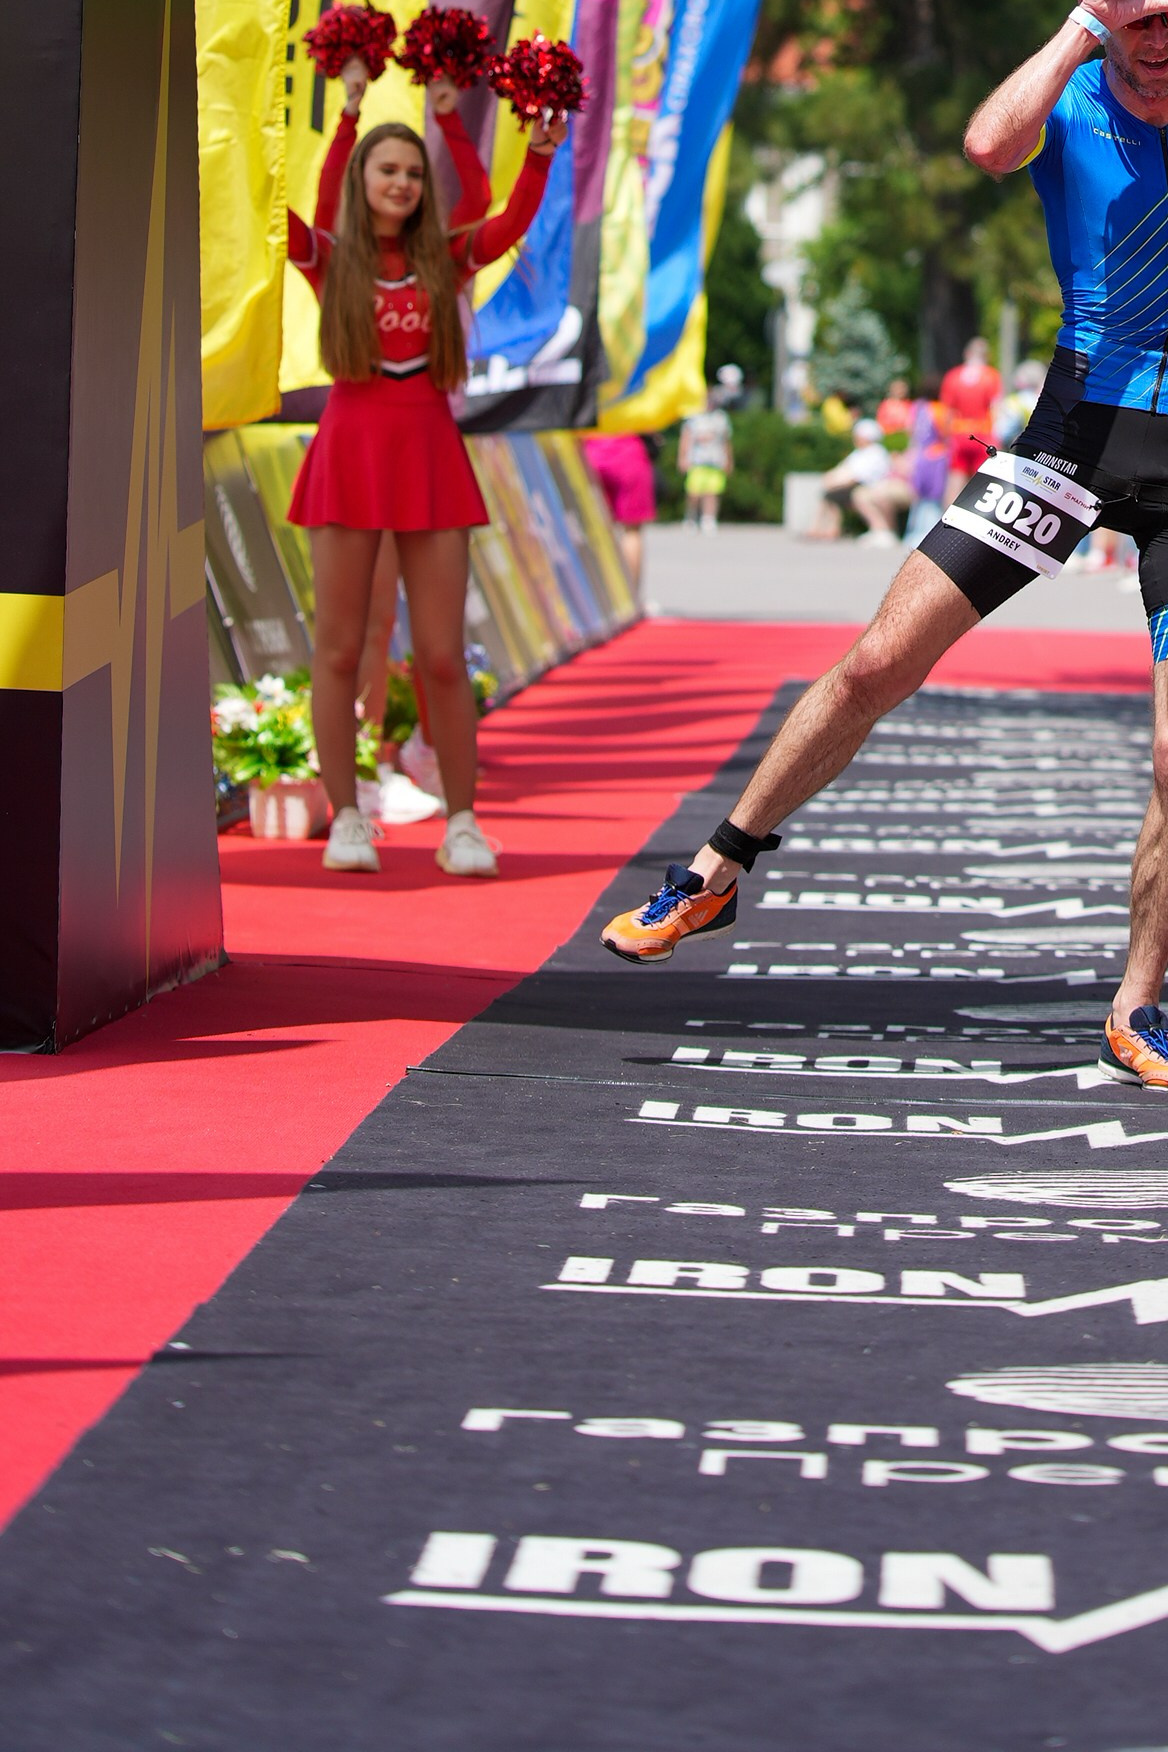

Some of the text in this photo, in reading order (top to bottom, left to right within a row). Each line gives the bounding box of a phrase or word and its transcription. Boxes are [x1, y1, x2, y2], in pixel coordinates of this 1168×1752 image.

[1022, 466, 1040, 479] IRON
[1043, 476, 1062, 491] STAR
[1035, 451, 1079, 477] IRONSTAR
[974, 482, 1062, 545] 3020
[987, 528, 1021, 553] ANDREY
[670, 1045, 1003, 1076] IRON
[637, 1100, 1003, 1134] IRON
[557, 1256, 1027, 1299] IRON
[408, 1530, 1057, 1612] IRON
